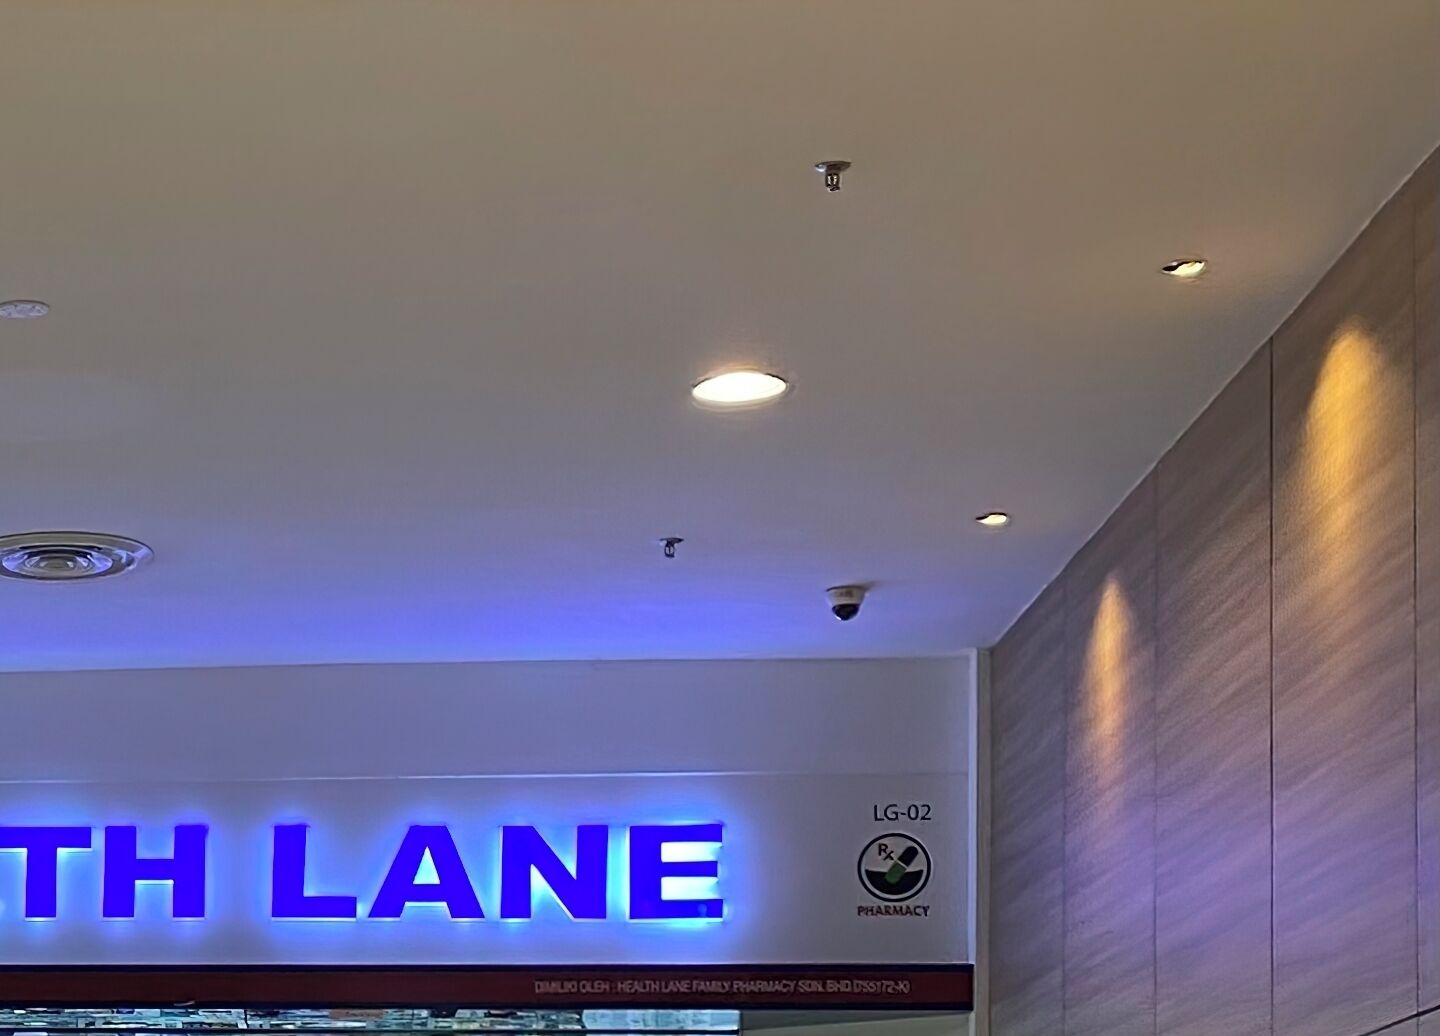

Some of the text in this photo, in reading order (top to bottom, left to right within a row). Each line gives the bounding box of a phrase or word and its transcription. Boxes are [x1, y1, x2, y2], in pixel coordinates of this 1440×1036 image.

[873, 804, 932, 821] LG-02
[271, 823, 724, 921] LANE
[857, 905, 930, 917] PHARMACY
[617, 980, 659, 993] HEALTH
[661, 980, 692, 993] LANE
[733, 980, 796, 993] PHARMACY
